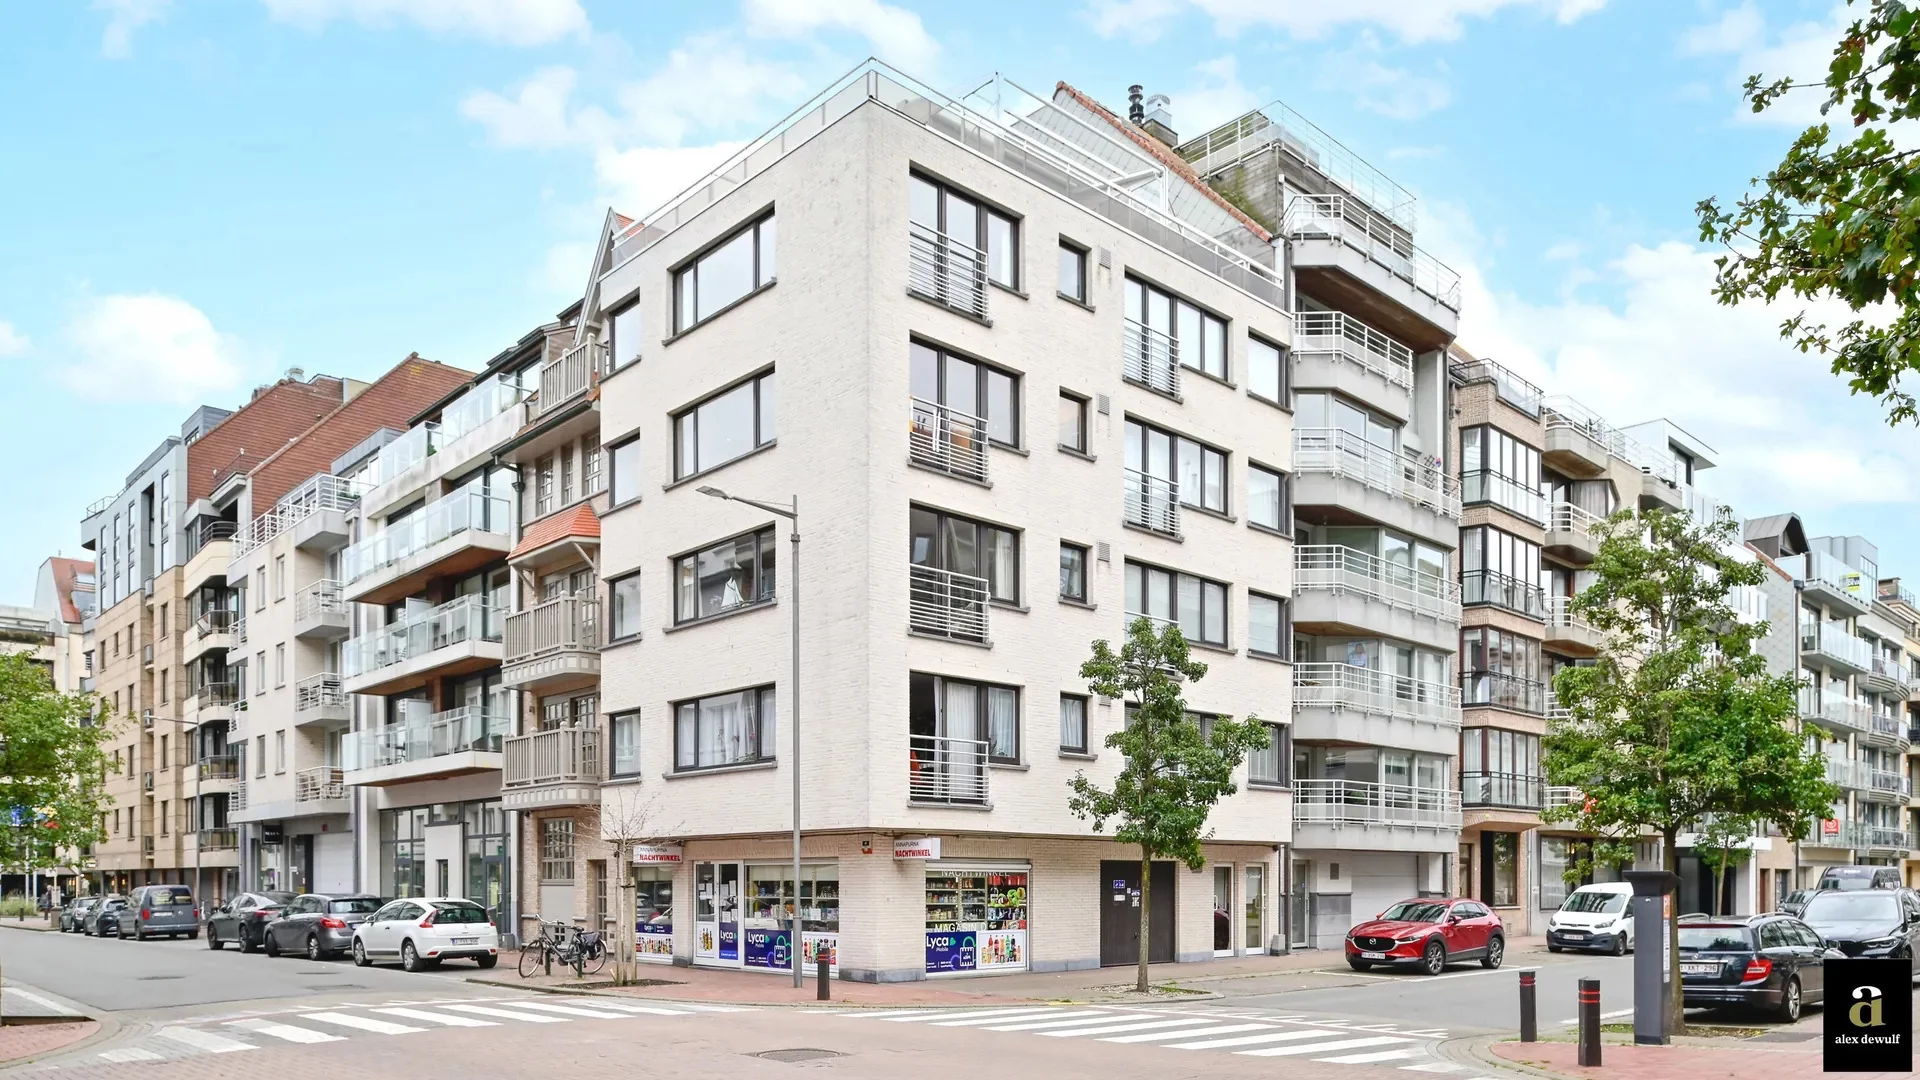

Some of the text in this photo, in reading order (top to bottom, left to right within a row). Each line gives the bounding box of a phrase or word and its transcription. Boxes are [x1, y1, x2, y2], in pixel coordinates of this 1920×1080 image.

[639, 854, 681, 862] NACHTWINKEL
[895, 849, 931, 858] NACHTWINKEL
[935, 922, 977, 932] MAGASIN
[720, 930, 734, 940] Lyca
[747, 931, 765, 944] Lyca
[926, 935, 949, 949] Lyca
